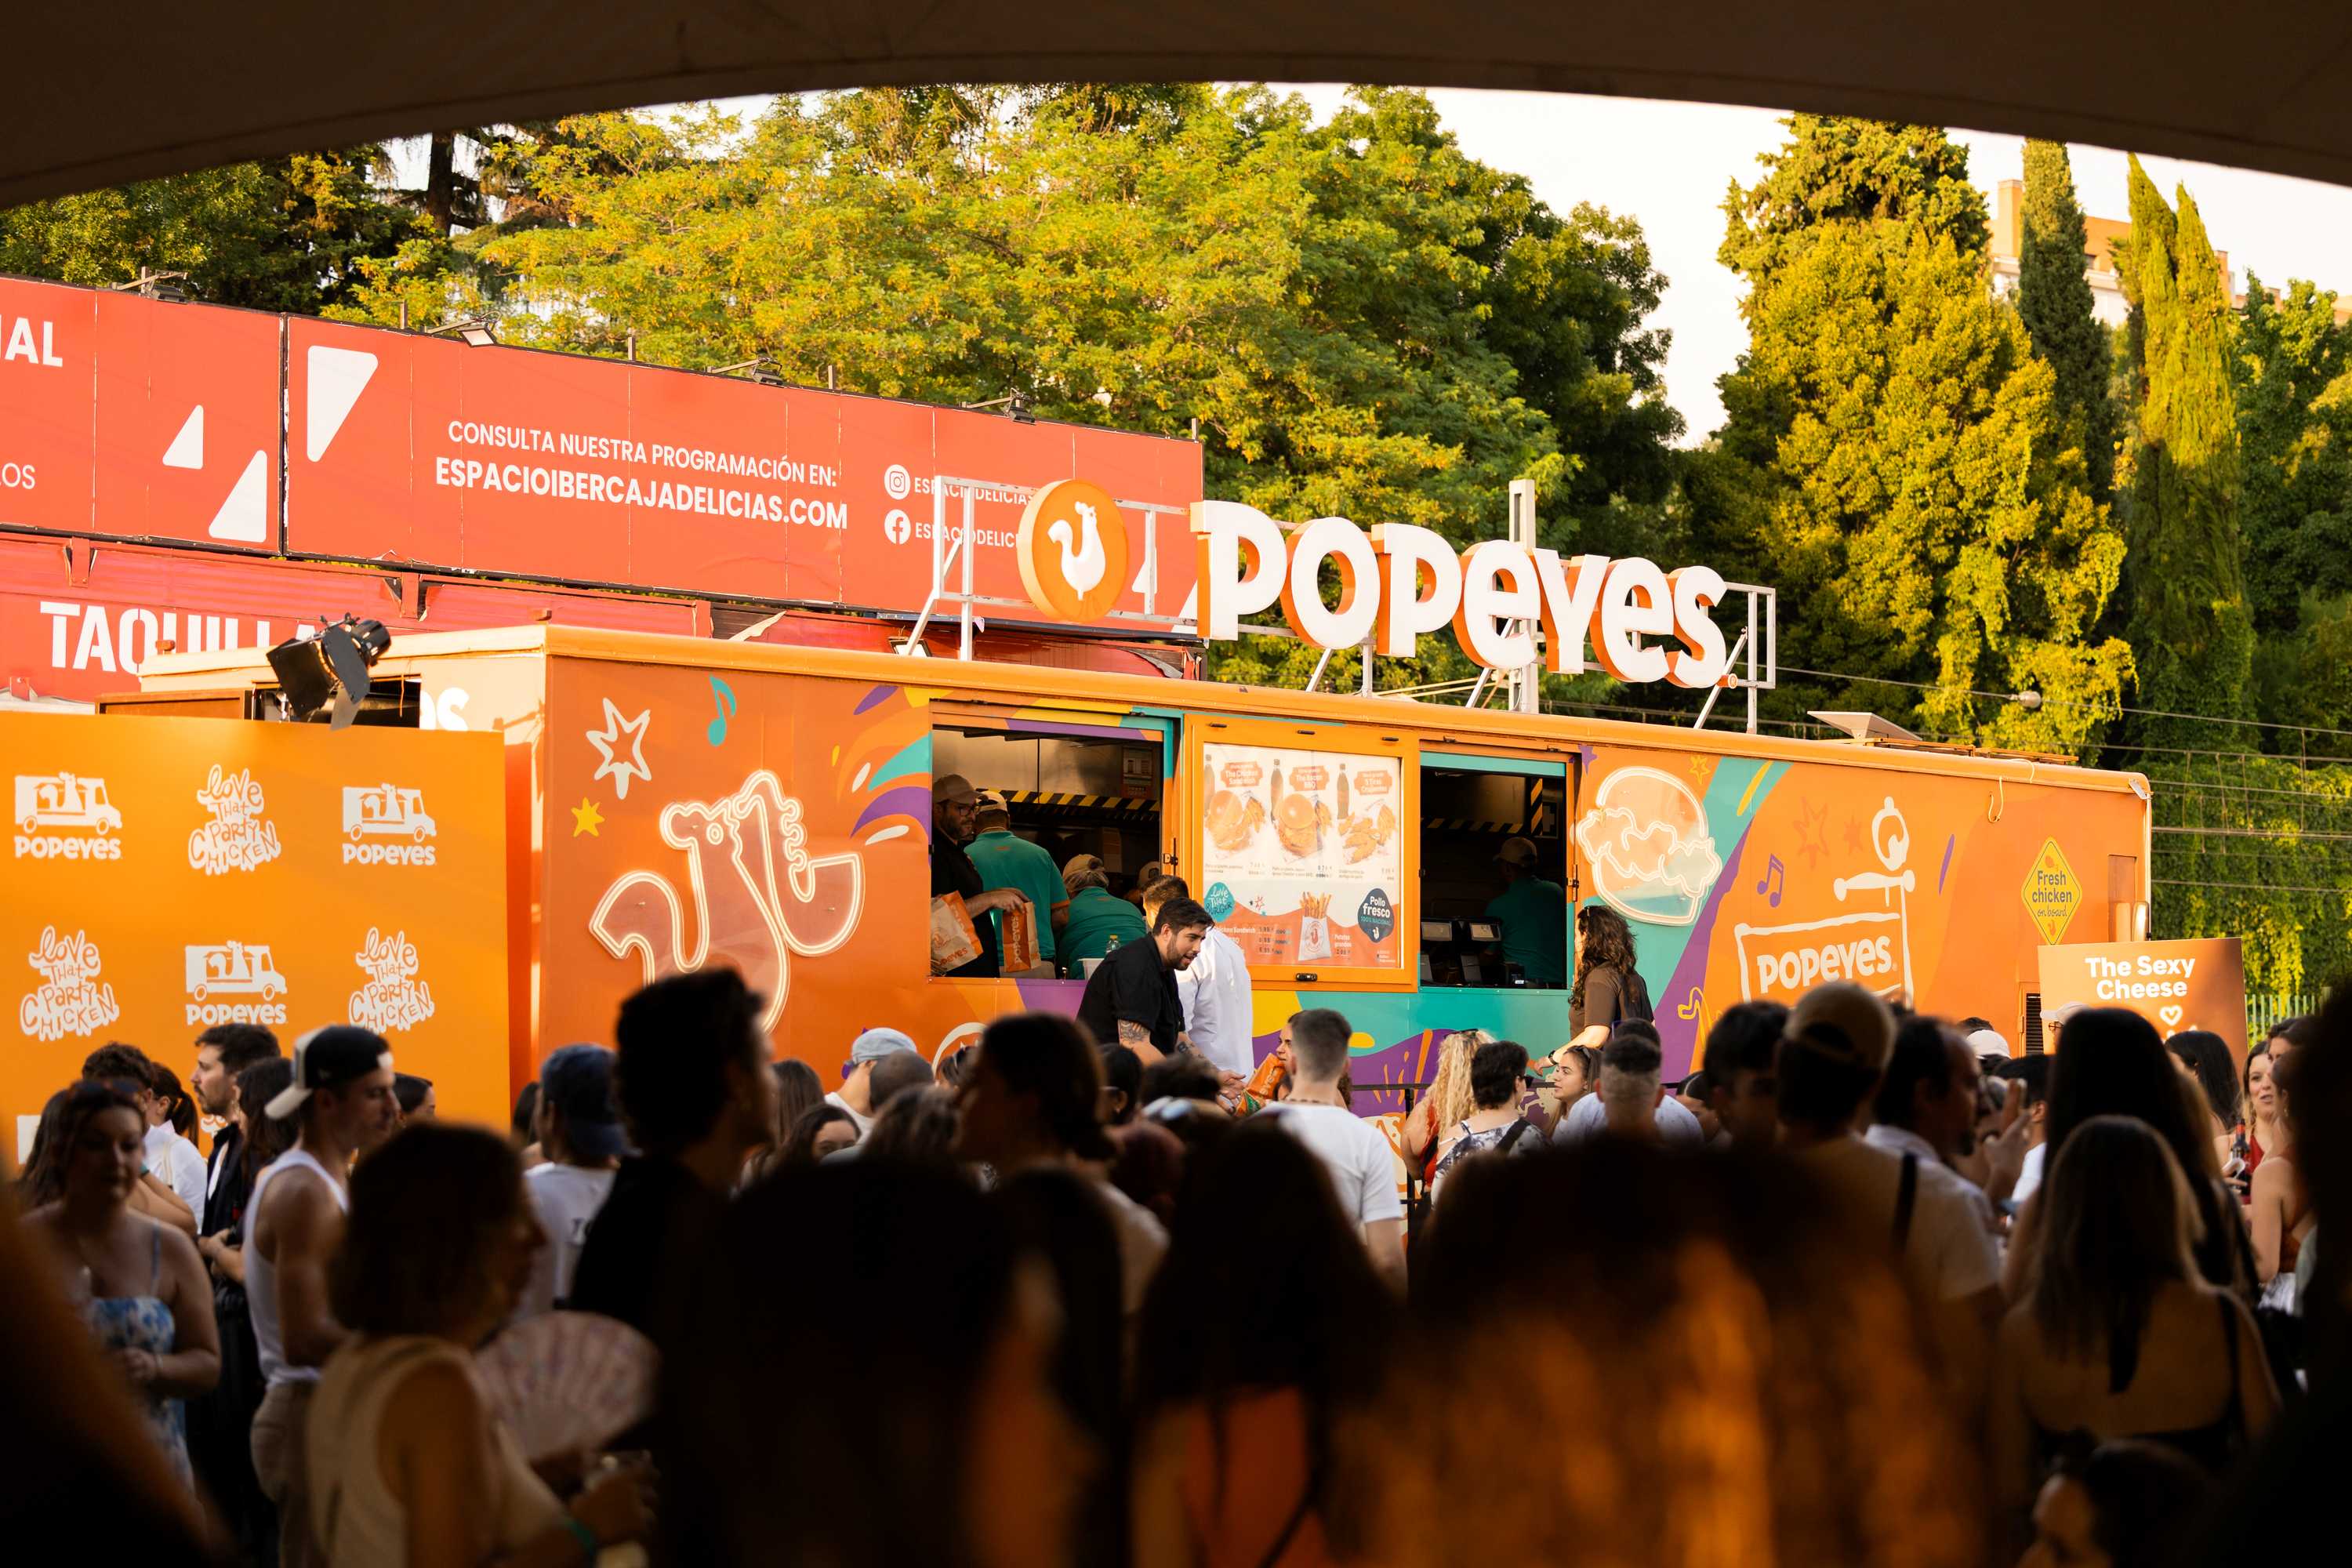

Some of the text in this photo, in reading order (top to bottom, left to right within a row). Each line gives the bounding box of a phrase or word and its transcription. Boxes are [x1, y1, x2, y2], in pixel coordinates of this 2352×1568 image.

[0, 316, 63, 367] AL
[448, 420, 837, 487] CONSULTA NUESTRA PROGRAMACIÓN EN:
[0, 462, 35, 489] OS
[436, 456, 848, 529] ESPACIOIBERCAJADELICIAS.COM
[2037, 869, 2067, 885] Fresh
[1370, 896, 1385, 907] Pollo
[2032, 887, 2072, 903] chicken
[1363, 903, 1391, 918] fresco
[2085, 955, 2195, 978] The Sexy
[2096, 979, 2187, 1000] Cheese
